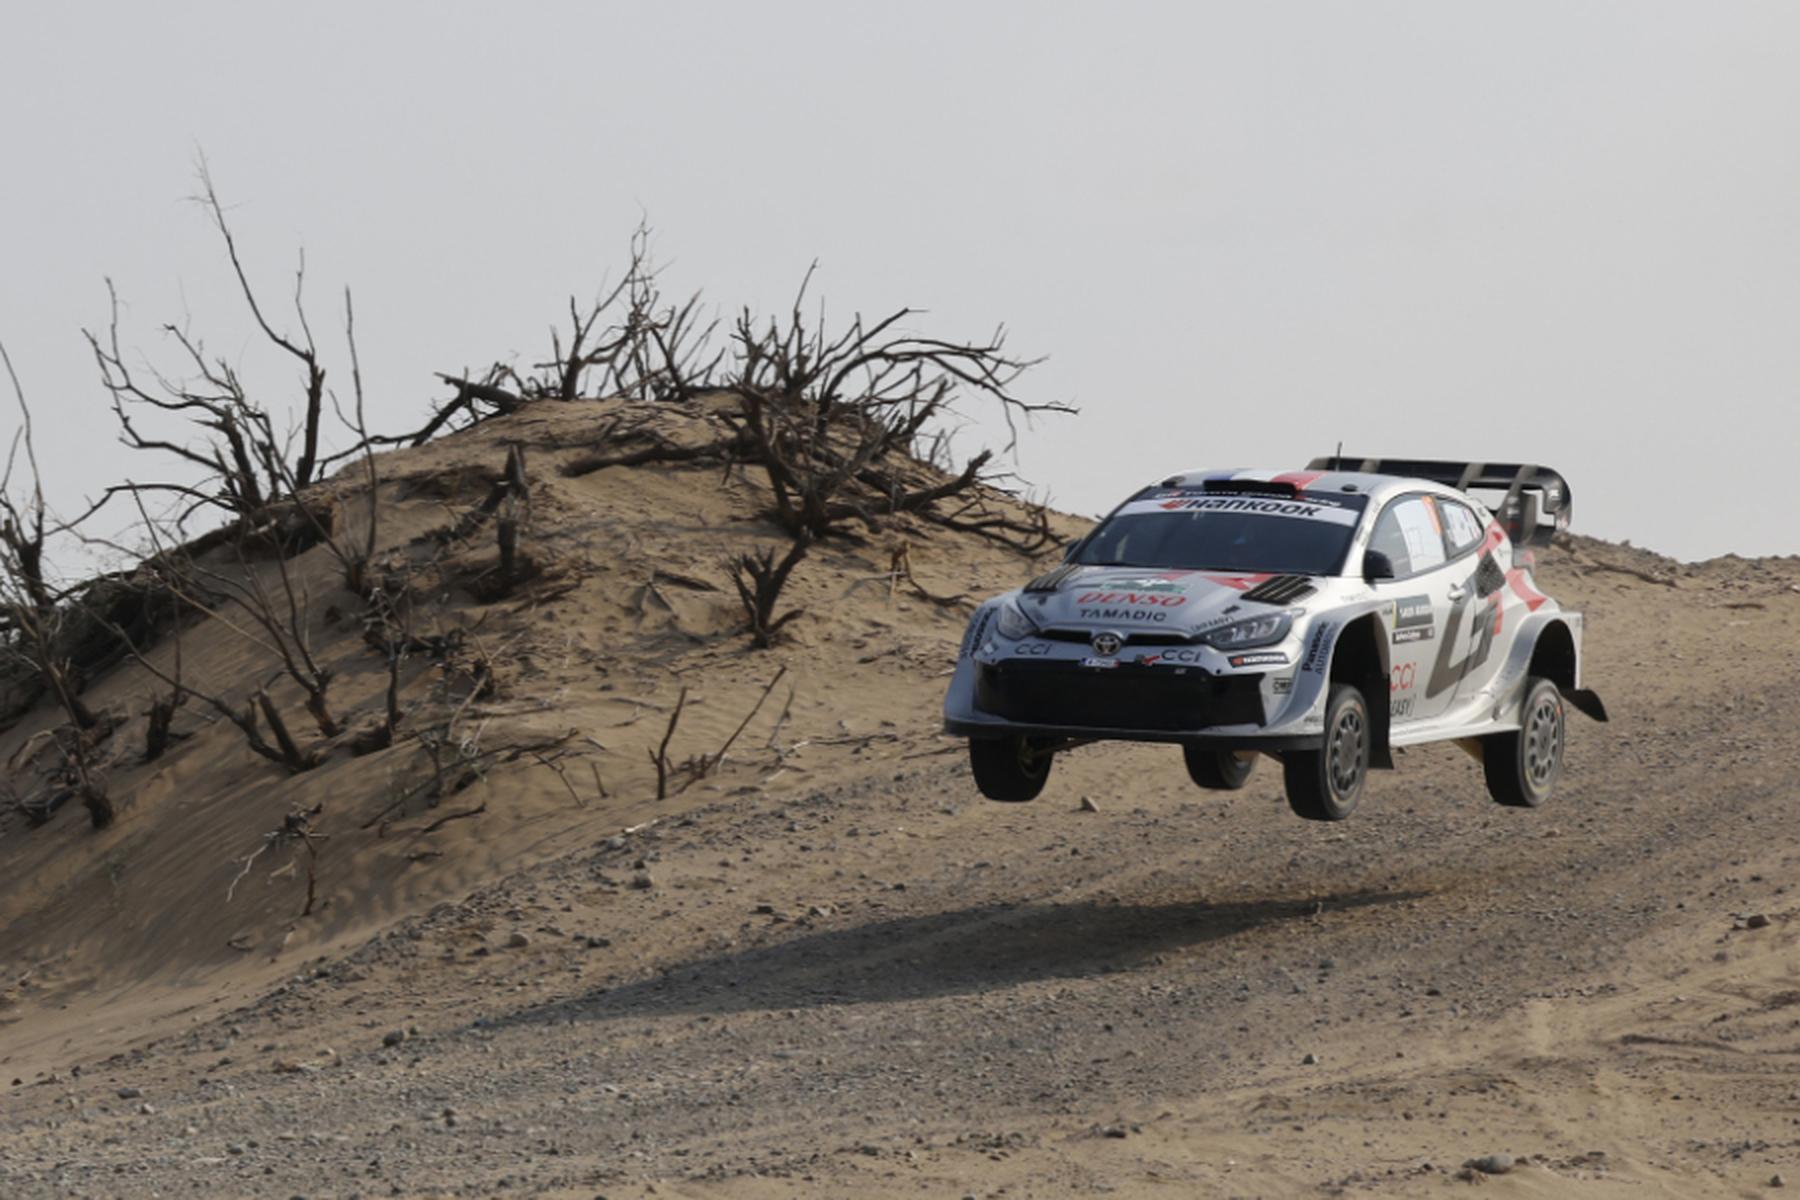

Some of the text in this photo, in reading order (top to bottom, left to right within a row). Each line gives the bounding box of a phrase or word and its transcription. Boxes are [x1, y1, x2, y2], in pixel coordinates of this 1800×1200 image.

[1077, 592, 1187, 607] DENSO
[1080, 608, 1167, 622] TAMADIC
[1014, 643, 1053, 655] CCI
[1161, 649, 1202, 662] CCI
